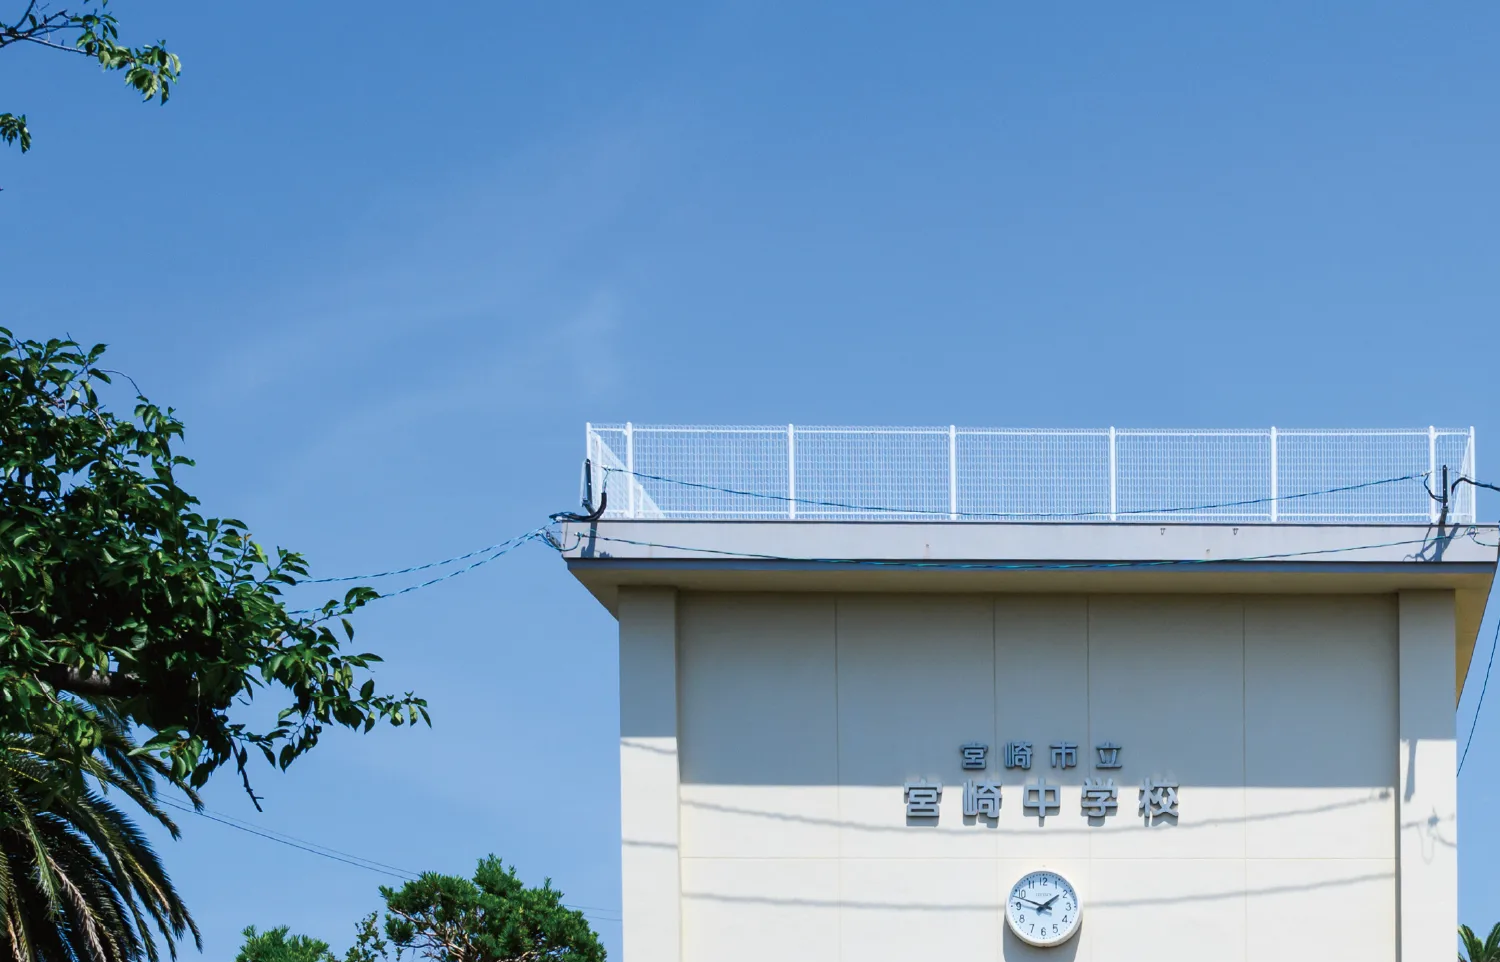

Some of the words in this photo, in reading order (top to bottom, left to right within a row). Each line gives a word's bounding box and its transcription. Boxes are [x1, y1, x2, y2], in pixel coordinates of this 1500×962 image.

[959, 740, 1123, 770] 宮崎市立
[903, 777, 1180, 819] 宮崎中学校
[1028, 880, 1035, 889] 11
[1039, 877, 1048, 887] 12
[1054, 880, 1058, 889] 1
[1018, 889, 1026, 899] 10
[1062, 889, 1069, 899] 2
[1016, 901, 1022, 911] 9
[1066, 902, 1072, 911] 3
[1019, 914, 1025, 924] 8
[1061, 914, 1068, 923] 4
[1029, 924, 1035, 933] 7
[1041, 927, 1047, 937] 6
[1052, 924, 1059, 933] 5
